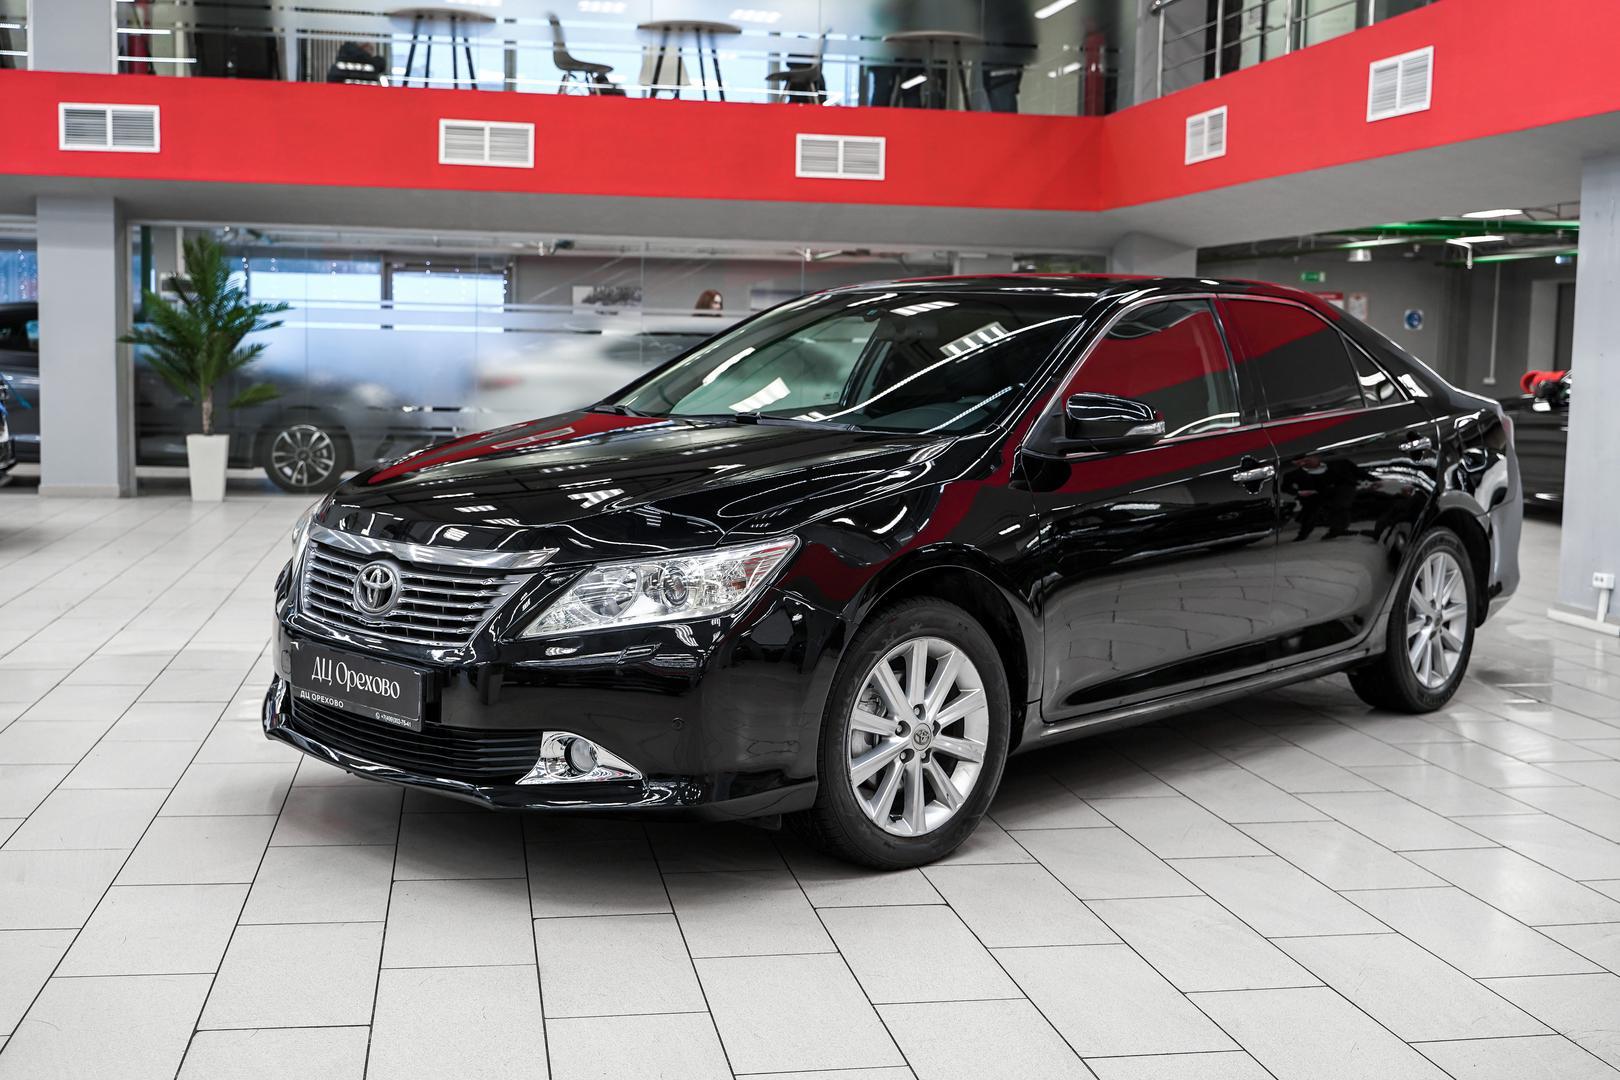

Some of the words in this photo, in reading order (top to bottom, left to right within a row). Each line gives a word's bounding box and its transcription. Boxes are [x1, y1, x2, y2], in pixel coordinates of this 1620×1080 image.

[311, 656, 333, 686] ДЦ
[335, 661, 400, 699] Орехово
[300, 690, 311, 699] ДЦ
[311, 693, 344, 708] ОРЕХОВО
